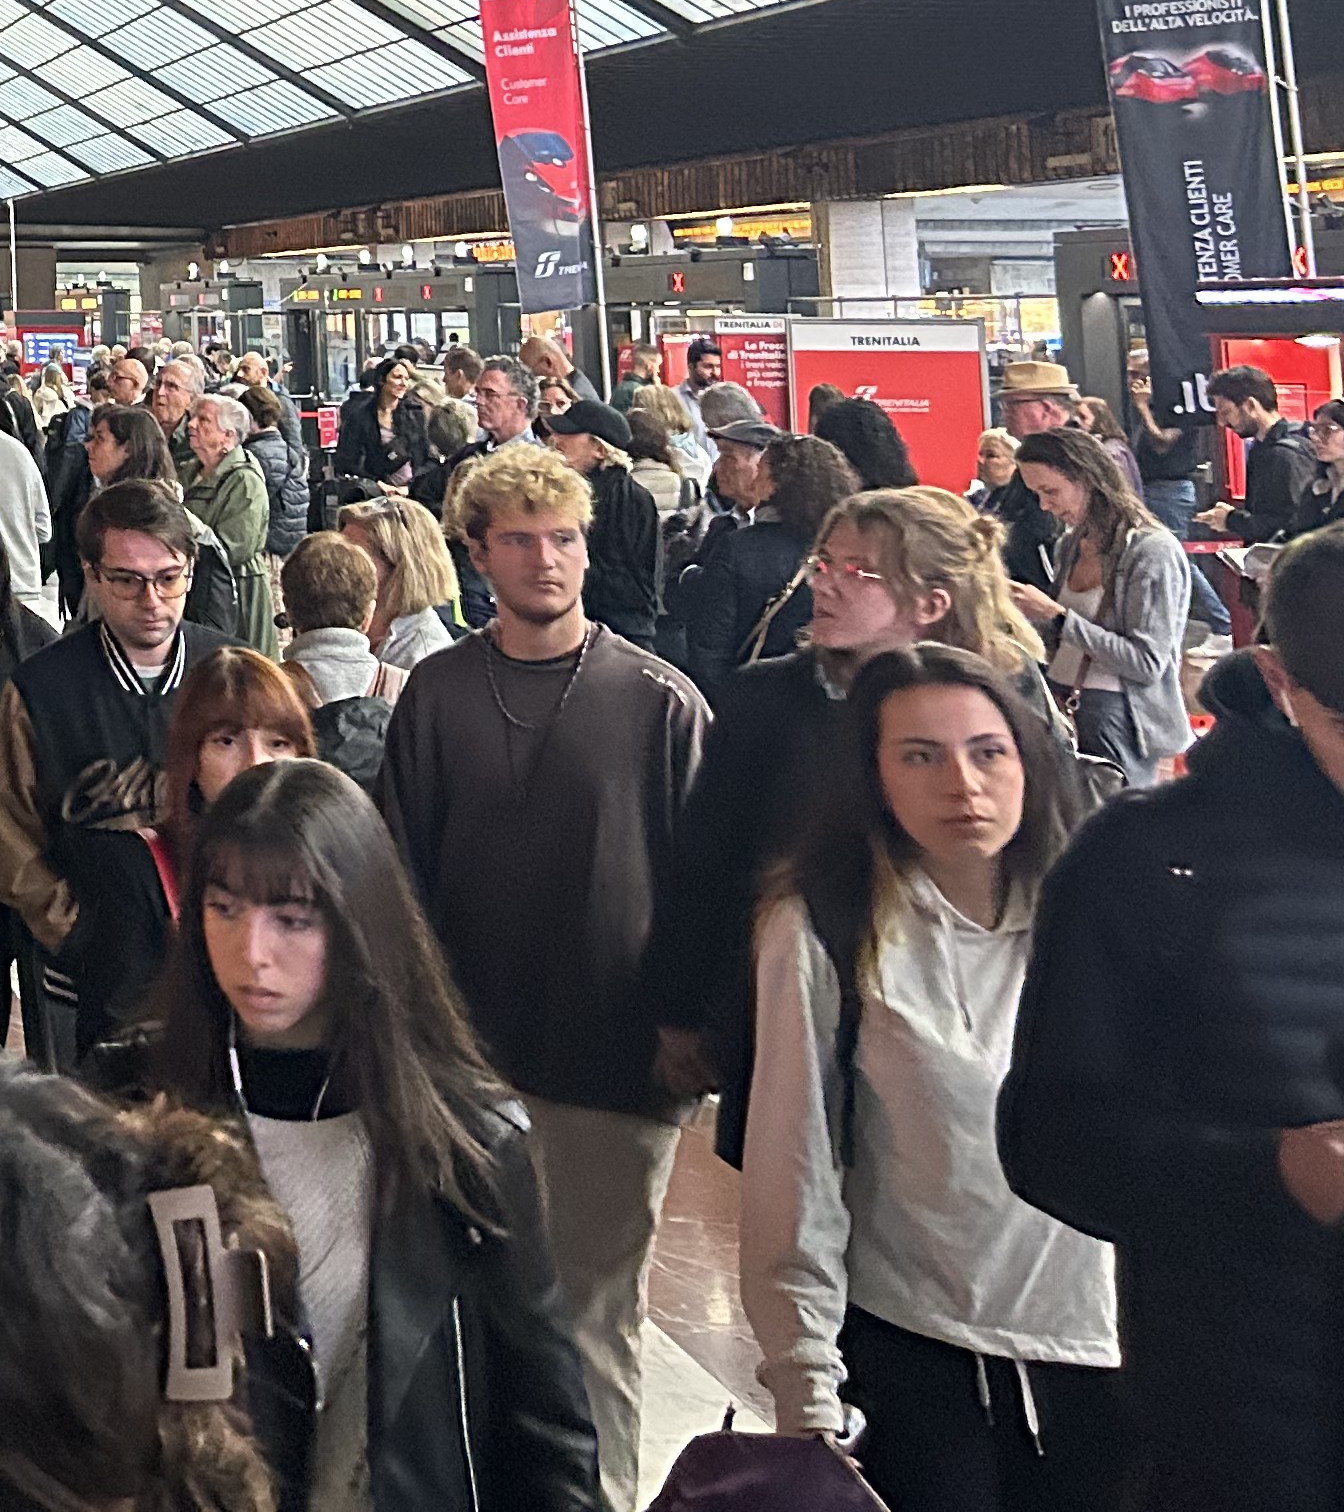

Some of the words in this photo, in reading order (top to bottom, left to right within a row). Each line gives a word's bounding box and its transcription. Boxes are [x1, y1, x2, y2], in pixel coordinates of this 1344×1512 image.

[1112, 18, 1185, 33] DELL'ALTA
[493, 26, 557, 43] Assistenza
[495, 43, 534, 57] Clienti
[501, 76, 547, 90] Customer
[1183, 160, 1210, 226] CLIENTI
[1212, 192, 1236, 236] CARE
[850, 336, 920, 346] TRENITALIA
[874, 399, 930, 407] TRENITALIA
